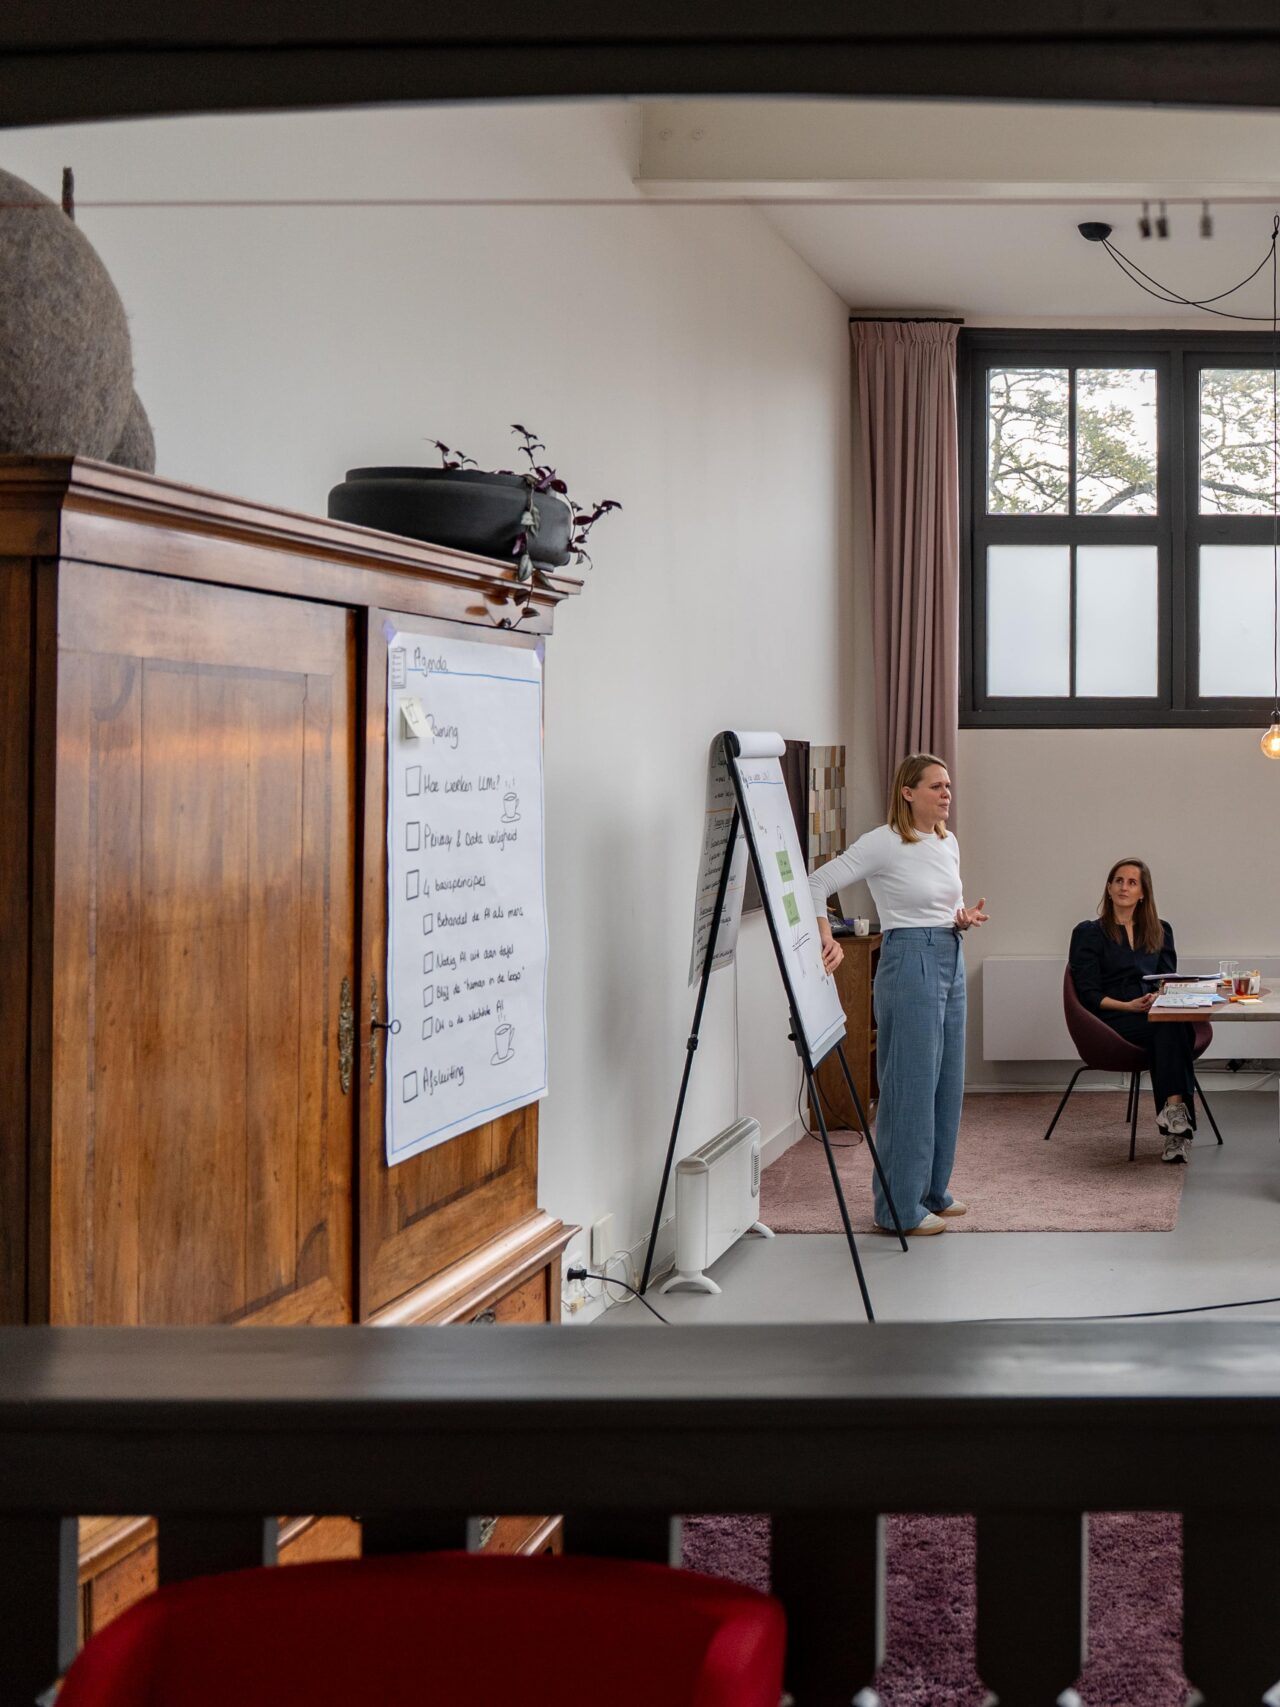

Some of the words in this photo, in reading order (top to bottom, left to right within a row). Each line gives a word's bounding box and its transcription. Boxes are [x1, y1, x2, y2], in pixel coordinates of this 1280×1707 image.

[423, 773, 440, 794] Hoe
[444, 775, 473, 794] werken
[424, 823, 452, 852] Privacy
